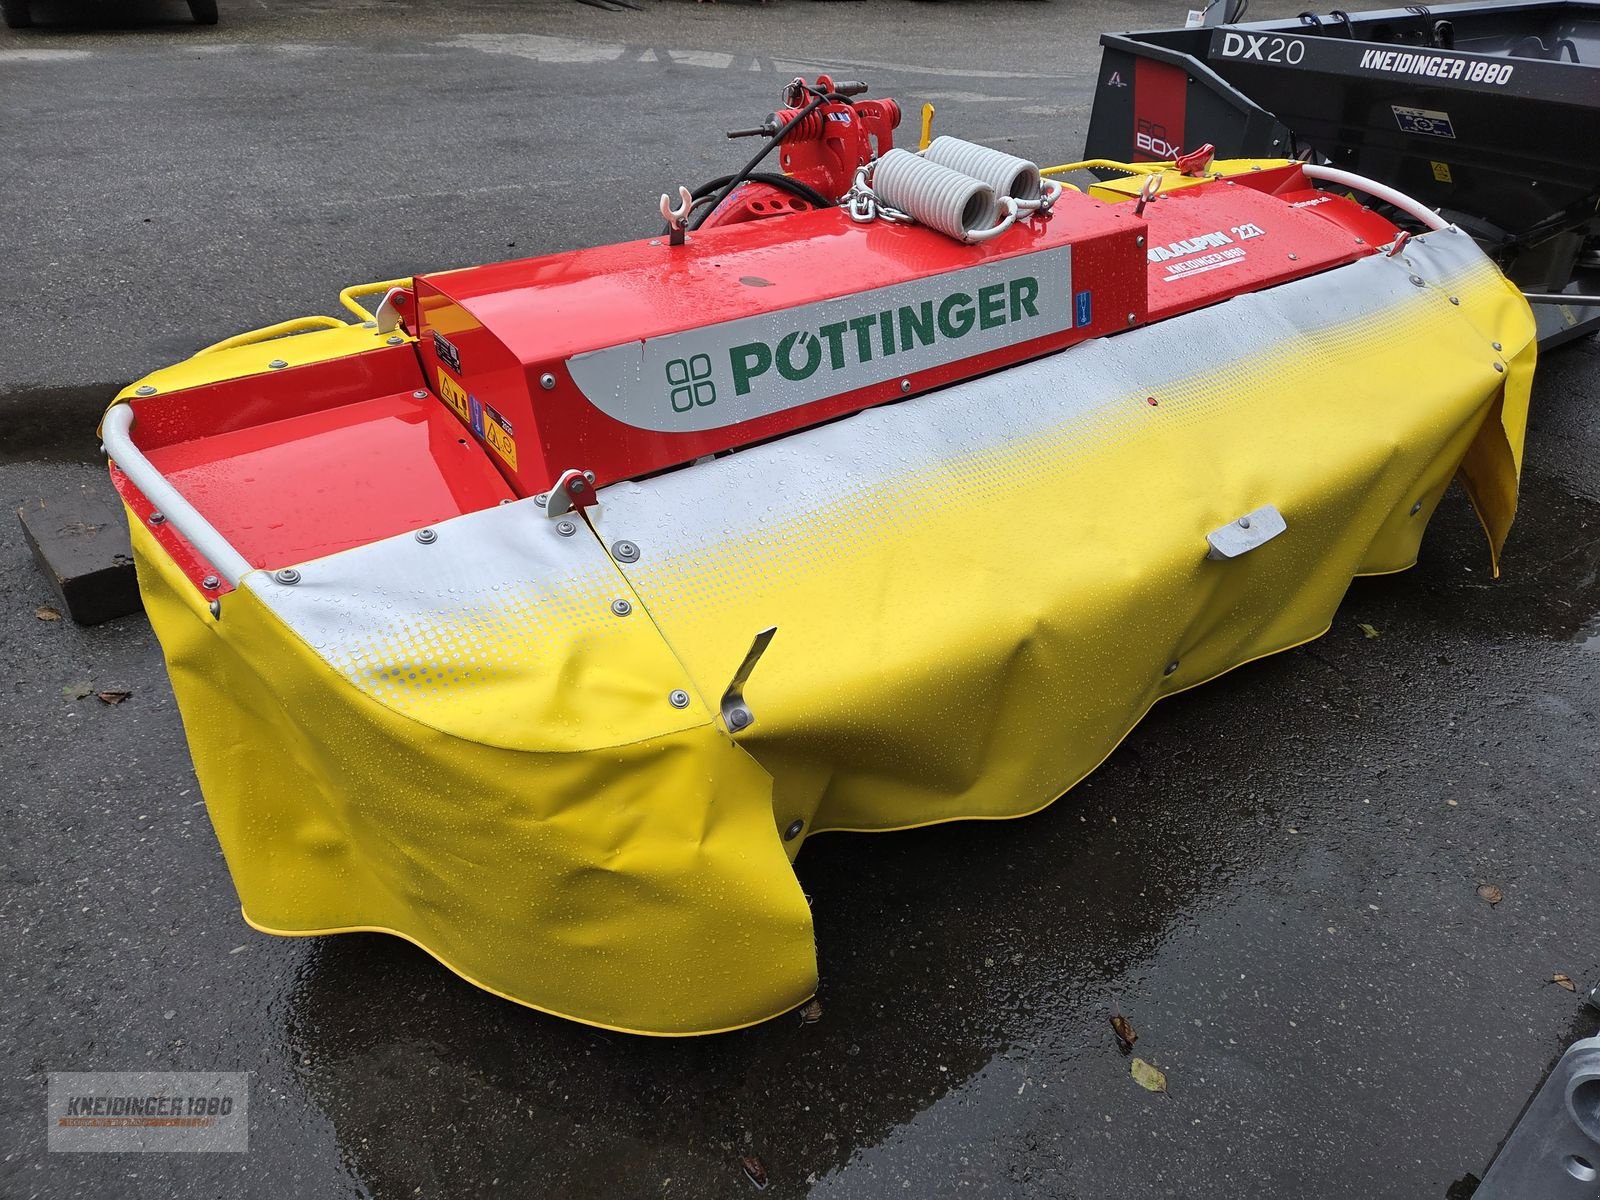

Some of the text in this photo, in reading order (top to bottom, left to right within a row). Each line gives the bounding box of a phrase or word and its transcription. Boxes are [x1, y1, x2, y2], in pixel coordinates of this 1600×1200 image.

[1222, 32, 1305, 65] DX20
[1359, 49, 1514, 85] KNEIDINGER 1880
[1136, 132, 1181, 158] BOX
[1147, 222, 1266, 264] VAALPIN 221
[1165, 251, 1225, 274] KNEIDINGER
[1221, 247, 1247, 261] 1880
[729, 276, 1039, 396] PÖTTINGER
